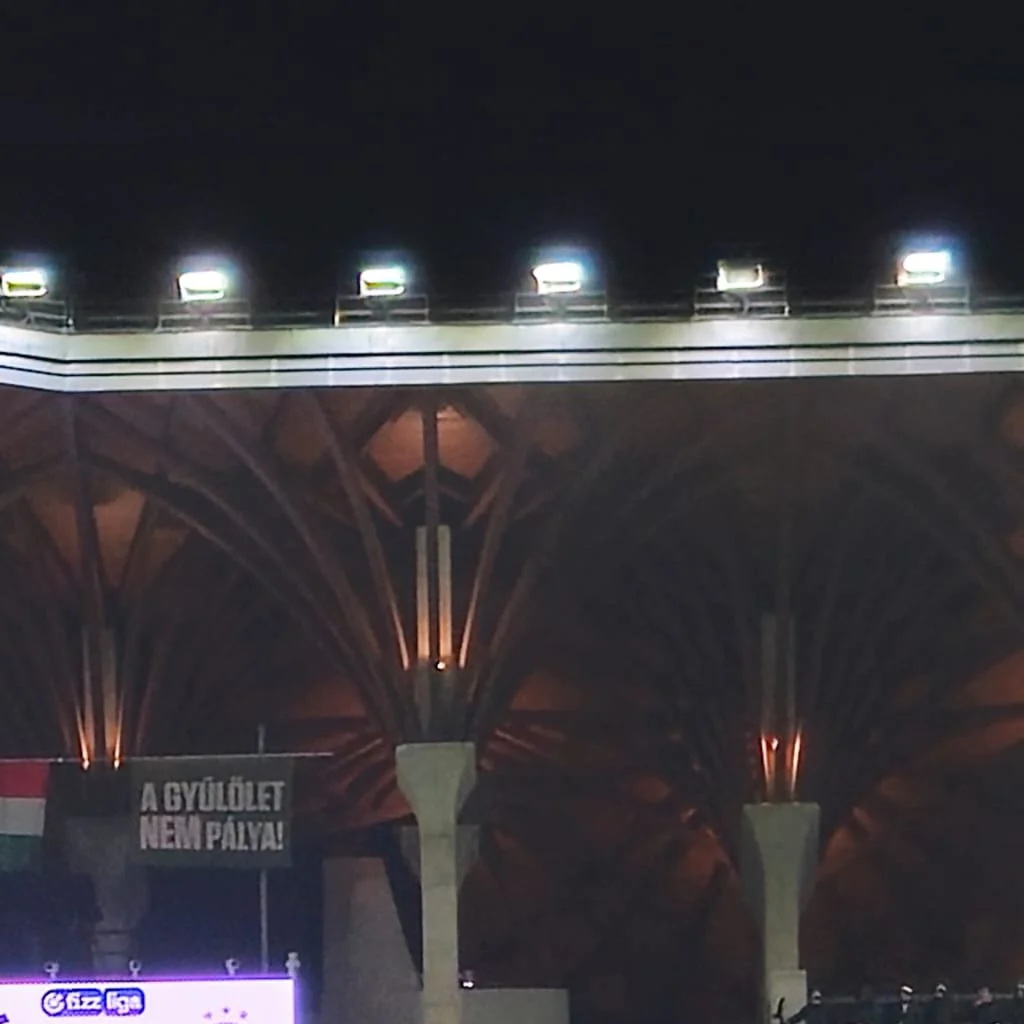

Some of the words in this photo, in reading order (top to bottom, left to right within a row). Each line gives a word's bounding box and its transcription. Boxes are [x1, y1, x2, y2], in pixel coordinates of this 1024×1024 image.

[141, 782, 158, 811] A
[140, 815, 201, 849] NEM
[206, 816, 283, 850] PÁLYA!
[106, 991, 142, 1014] liga
